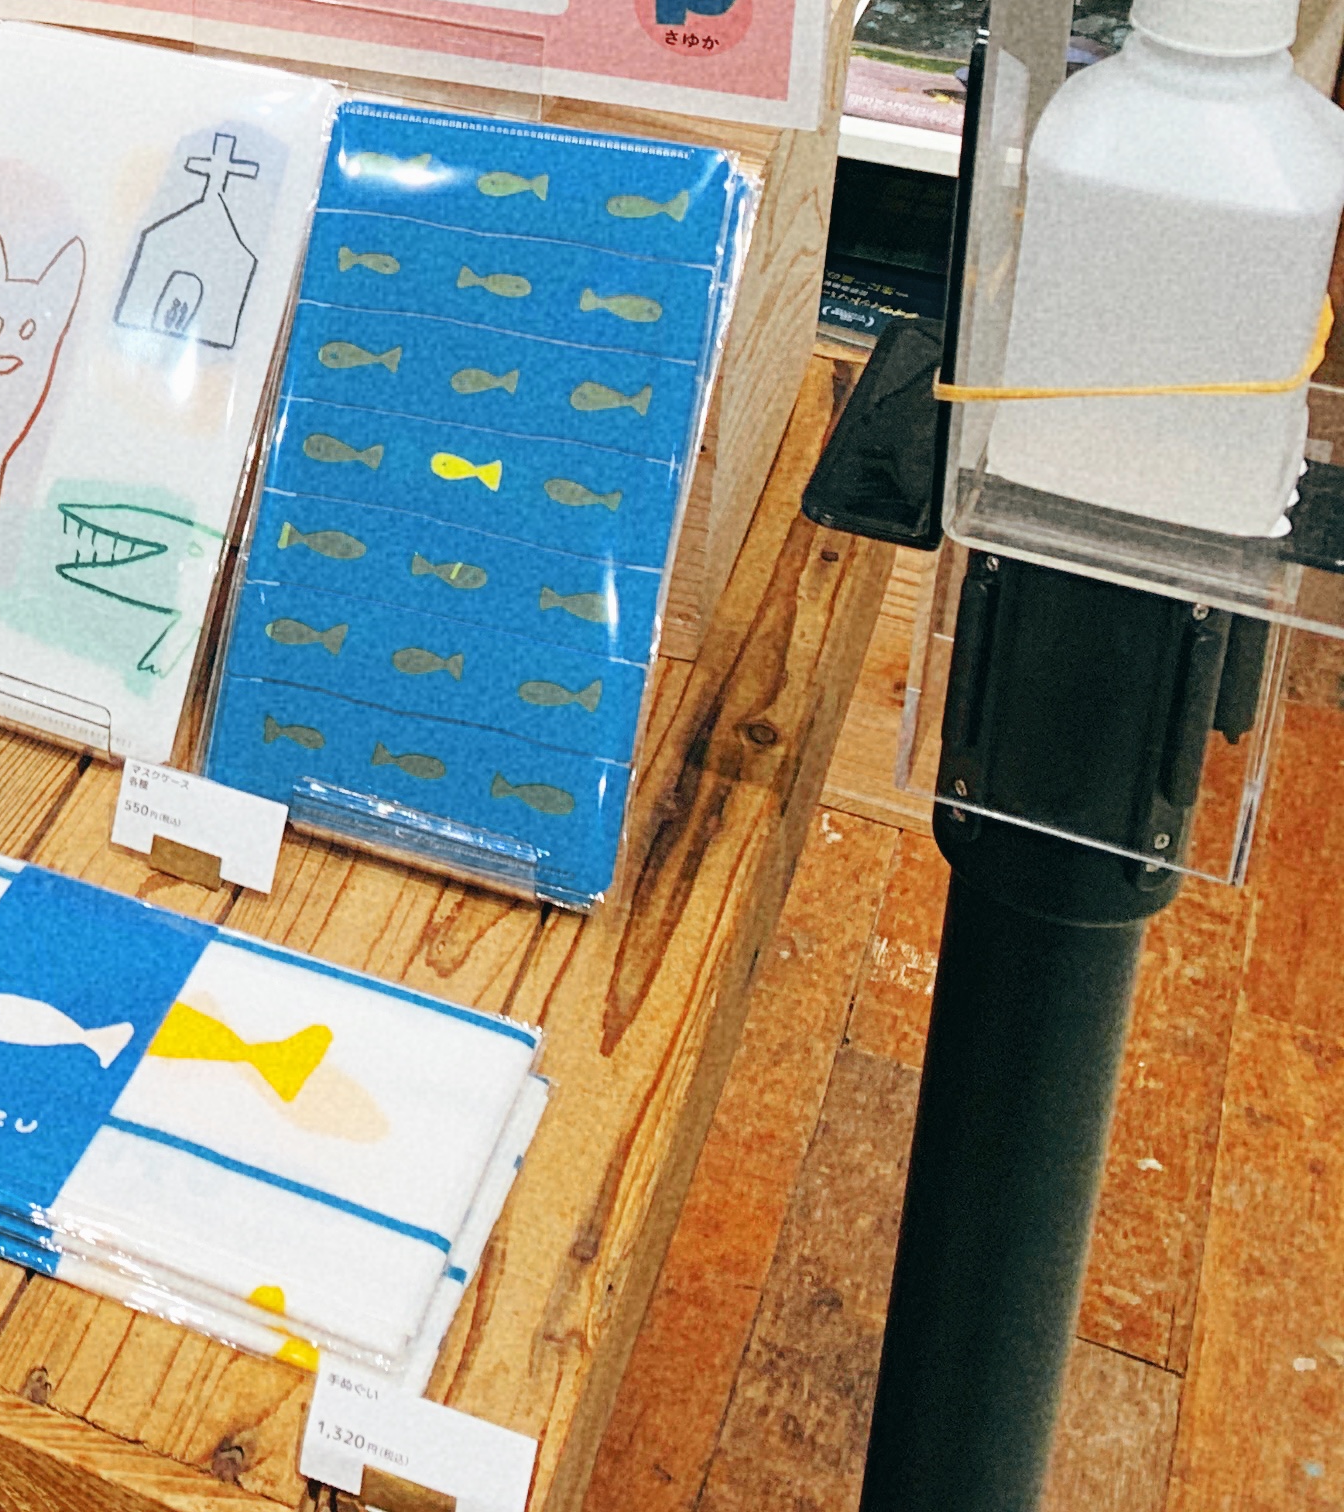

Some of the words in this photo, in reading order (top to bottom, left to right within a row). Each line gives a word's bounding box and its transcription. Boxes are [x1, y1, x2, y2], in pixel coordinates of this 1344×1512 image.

[663, 29, 721, 51] さゆか
[128, 775, 150, 791] 各種
[131, 764, 190, 790] マスクケース
[327, 1372, 380, 1401] 手ぬぐい
